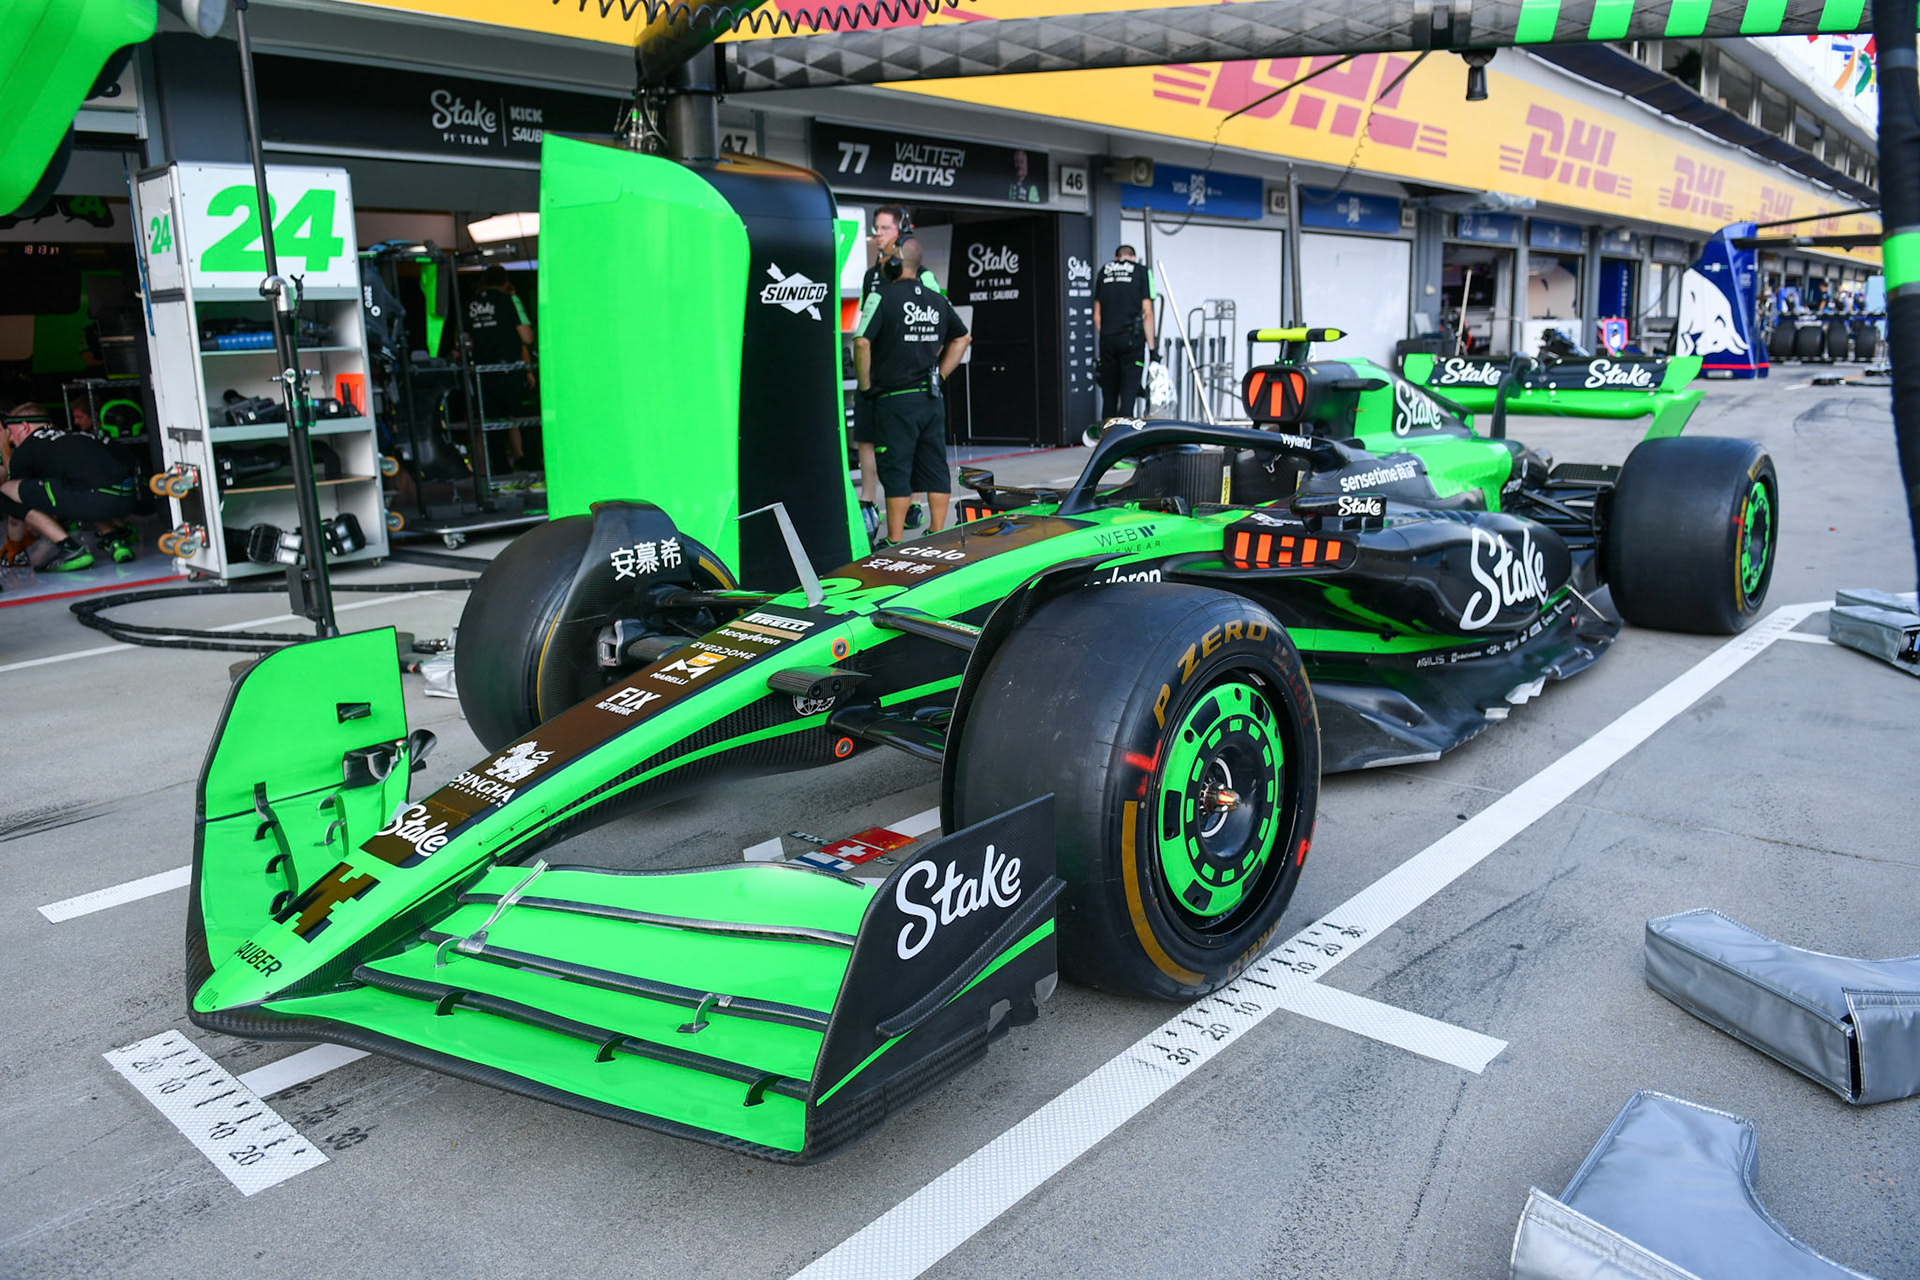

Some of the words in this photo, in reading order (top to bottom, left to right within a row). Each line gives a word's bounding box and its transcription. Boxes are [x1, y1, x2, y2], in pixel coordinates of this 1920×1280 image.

[430, 88, 498, 133] Stake
[1207, 52, 1419, 150] DHL
[509, 105, 543, 122] KICK
[443, 132, 456, 143] F1
[460, 133, 490, 146] TEAM
[511, 126, 543, 143] SAUB
[721, 134, 749, 155] 47
[837, 141, 871, 174] 77
[894, 140, 966, 168] VALTTERI
[1521, 103, 1619, 196] DHL
[890, 162, 956, 188] BOTTAS
[1065, 172, 1084, 191] 46
[1669, 154, 1726, 219] DHL
[150, 214, 172, 255] 24
[200, 185, 345, 273] 24
[968, 243, 1020, 278] Stake
[764, 284, 827, 302] SUNOCO
[989, 277, 1012, 287] TEAM
[903, 301, 940, 325] Stake
[1440, 357, 1502, 386] Stake
[1584, 358, 1653, 389] Stake
[1395, 379, 1442, 436] Stake
[1280, 433, 1313, 450] Hyland
[1340, 466, 1397, 493] sensetime
[1337, 495, 1382, 517] Stake
[1093, 527, 1139, 548] WEB
[609, 536, 683, 582] 安慕希
[899, 546, 967, 561] cielo
[1458, 527, 1550, 631] Stake
[767, 577, 910, 616] 24
[742, 611, 815, 632] PIRELLI
[690, 641, 758, 660] EVERDOME
[1416, 655, 1446, 669] AGILIS
[649, 672, 690, 686] MARELLI
[1153, 683, 1171, 730] P
[1177, 619, 1268, 685] ZERO
[594, 701, 636, 717] NETWORK
[605, 686, 662, 711] FIX
[448, 782, 504, 808] ORPORATION
[452, 770, 518, 803] SINGHA
[374, 804, 449, 858] Stake
[895, 844, 1022, 960] Stake
[234, 939, 283, 978] AUBER
[1291, 961, 1318, 975] 10
[1234, 1001, 1262, 1017] 10
[1201, 1022, 1232, 1042] 20
[155, 1077, 188, 1095] 10
[208, 1120, 238, 1140] 10
[228, 1144, 266, 1166] 20
